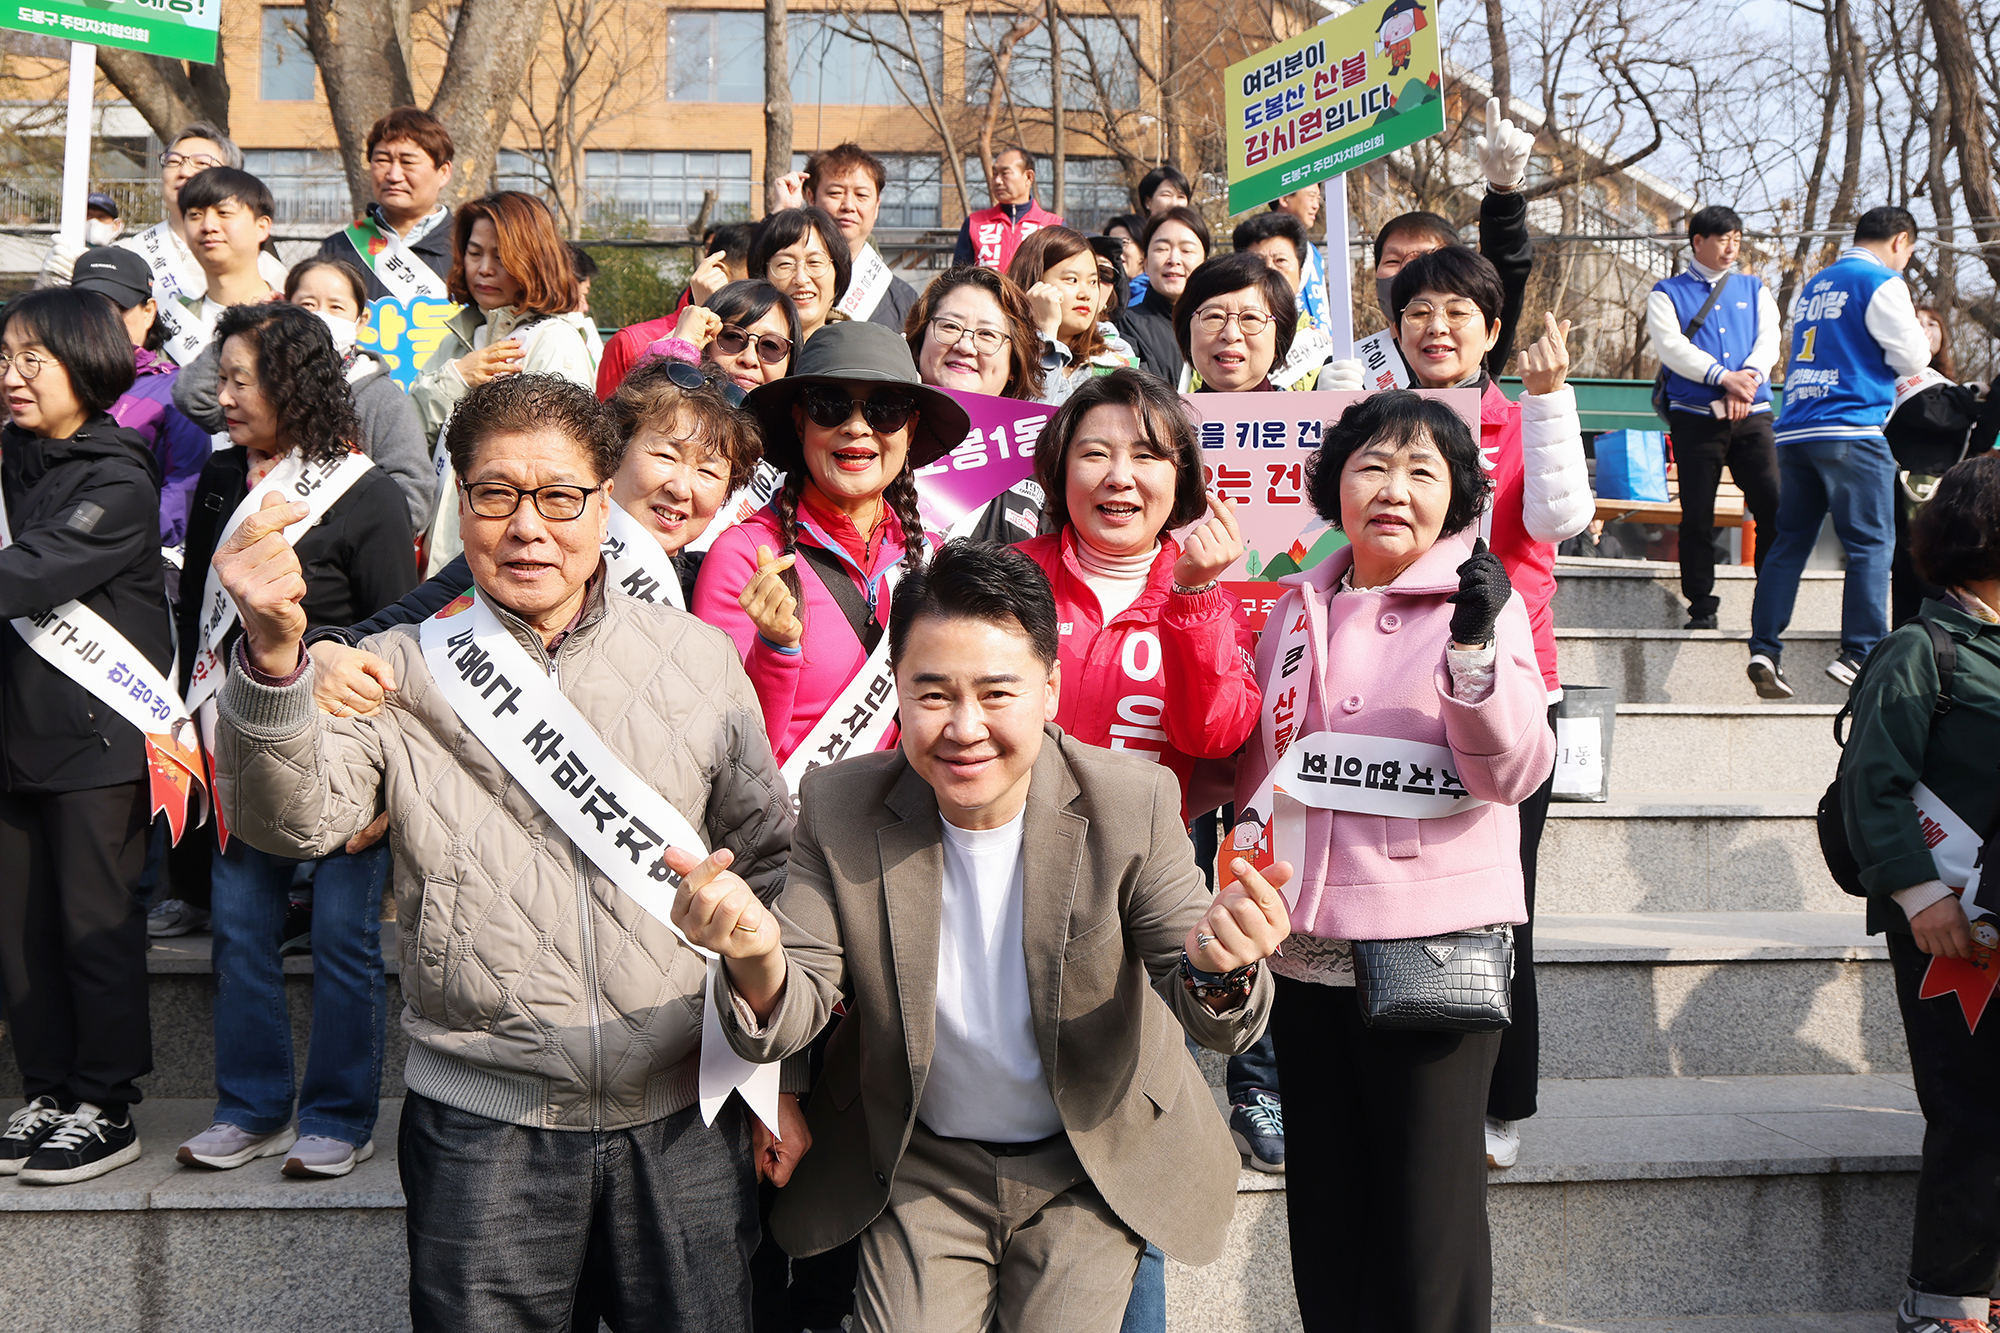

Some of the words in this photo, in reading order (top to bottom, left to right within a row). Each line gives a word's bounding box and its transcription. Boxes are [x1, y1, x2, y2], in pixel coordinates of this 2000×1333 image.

[18, 7, 59, 26] 도봉구
[60, 14, 150, 43] 주민자치협의회
[1243, 40, 1325, 96] 여러분이
[1244, 84, 1305, 130] 도봉산
[1313, 51, 1366, 101] 산불
[1245, 83, 1391, 167] 감시원입니다
[1281, 164, 1311, 187] 도봉구
[1313, 133, 1385, 173] 주민자치협의회
[861, 256, 883, 289] 에서는
[1361, 338, 1386, 370] 작은
[1795, 326, 1817, 362] 1
[1192, 422, 1225, 449] 을
[1236, 421, 1286, 449] 키운
[1297, 421, 1321, 449] 건
[1266, 463, 1301, 504] 건
[447, 627, 523, 718] 도봉구
[1281, 644, 1306, 678] 큰
[107, 661, 171, 721] 한평생
